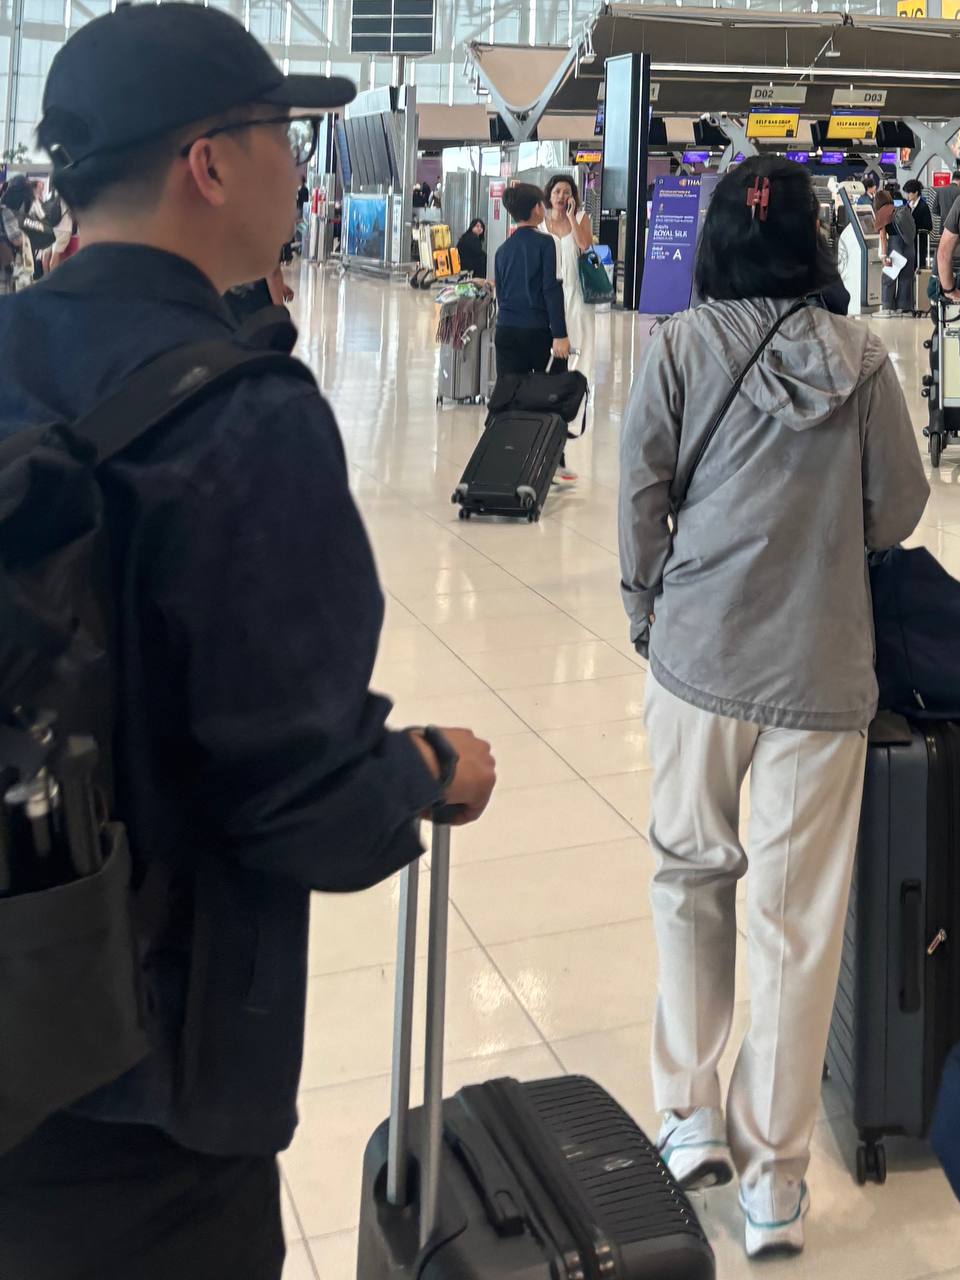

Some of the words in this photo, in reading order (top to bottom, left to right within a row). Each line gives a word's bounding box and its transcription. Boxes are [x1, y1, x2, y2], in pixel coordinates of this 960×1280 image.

[754, 89, 774, 99] D02
[864, 93, 882, 102] D03
[672, 248, 682, 261] A
